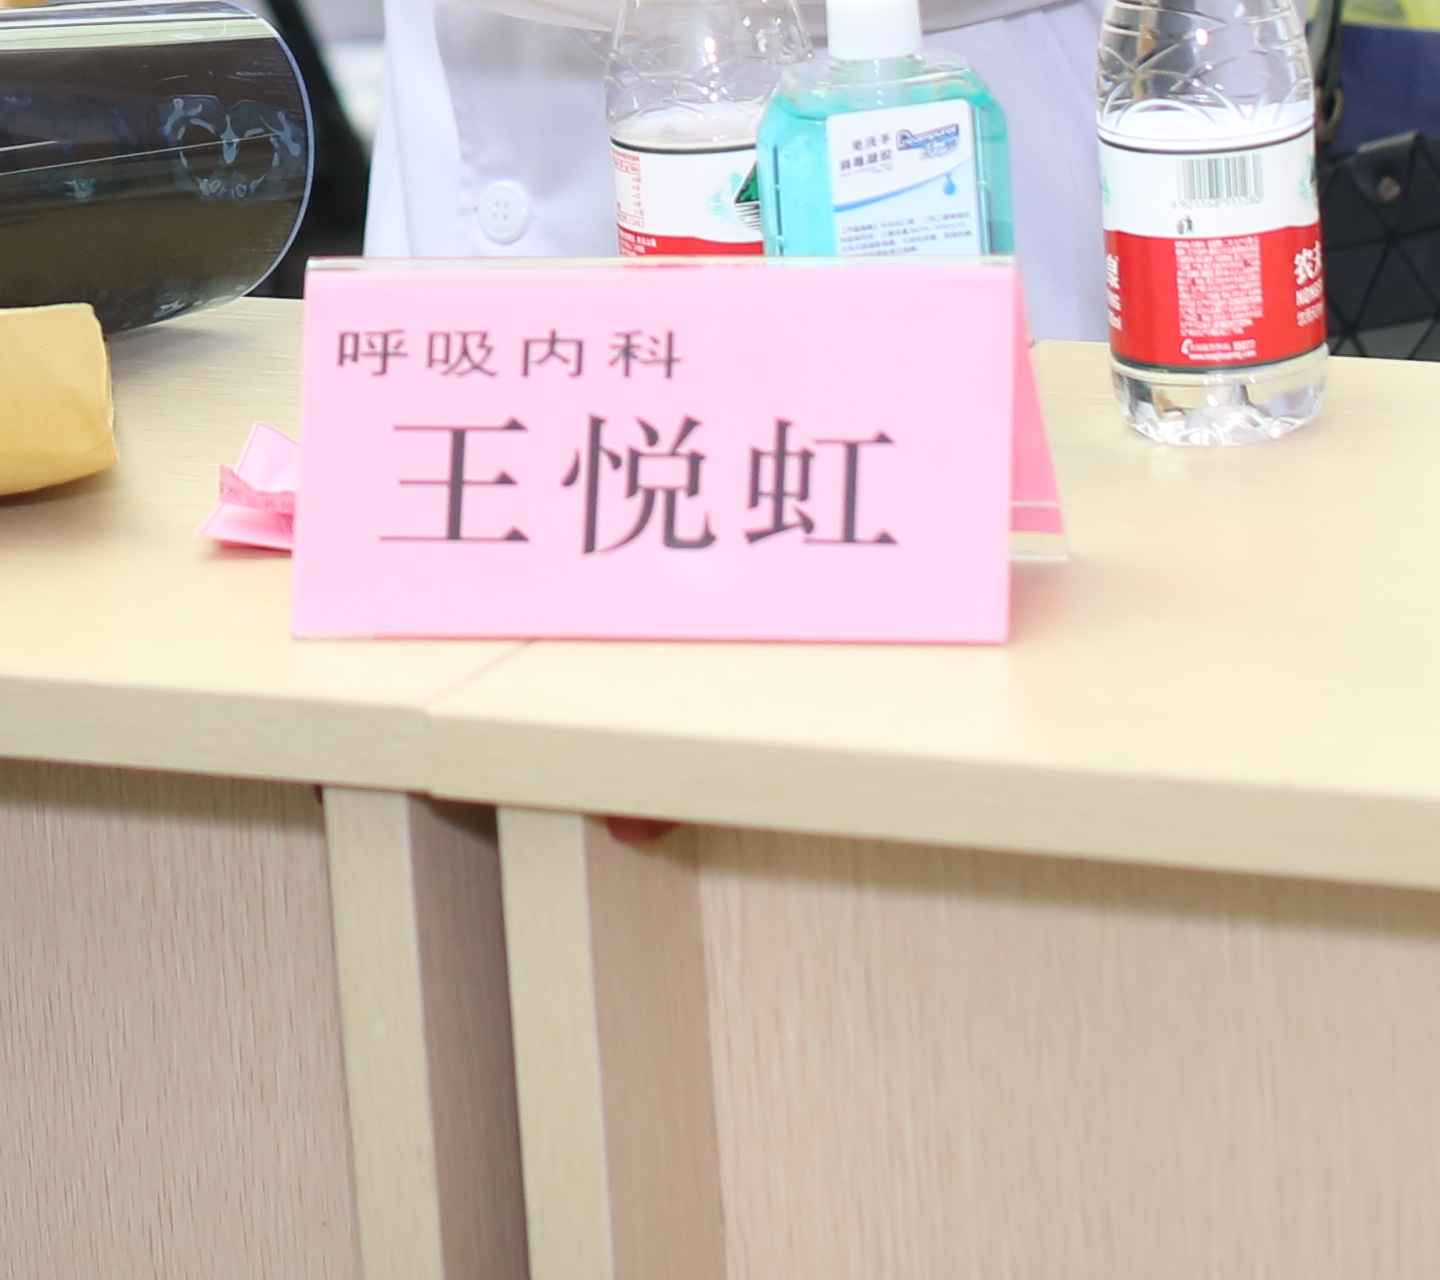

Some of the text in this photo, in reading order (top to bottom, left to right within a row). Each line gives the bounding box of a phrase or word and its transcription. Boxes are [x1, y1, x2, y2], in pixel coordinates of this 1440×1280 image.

[336, 328, 683, 380] 呼吸内科
[379, 414, 899, 556] 王悦虹
